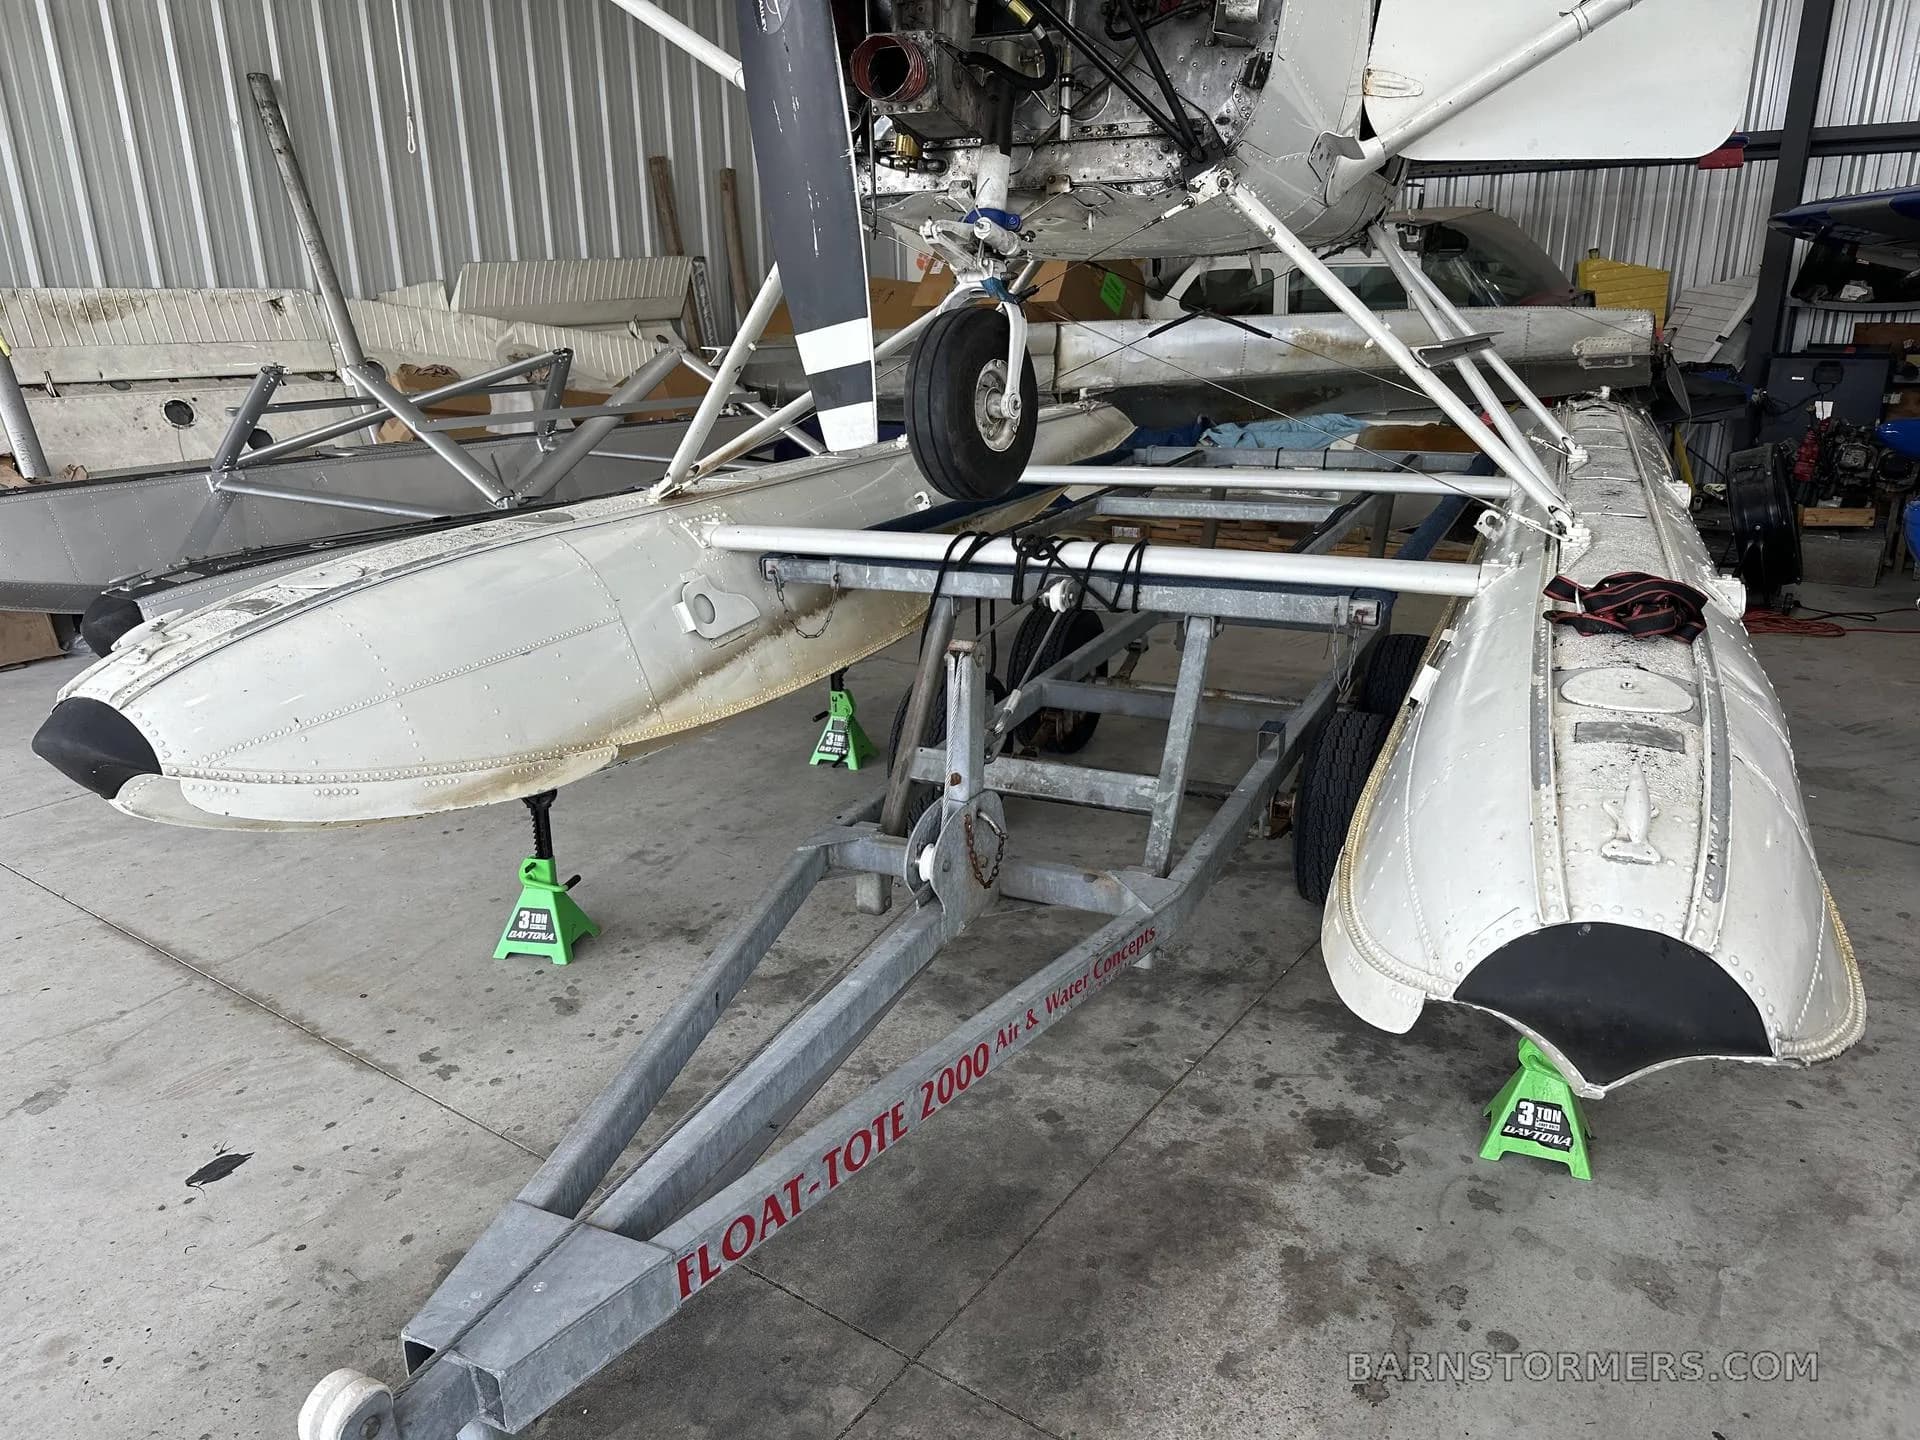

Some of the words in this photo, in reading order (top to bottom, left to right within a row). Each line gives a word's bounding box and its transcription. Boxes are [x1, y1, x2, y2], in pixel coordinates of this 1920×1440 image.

[825, 732, 835, 746] 3
[518, 910, 531, 929] 3
[531, 913, 548, 924] TON
[508, 930, 555, 941] DAYTONA
[676, 1101, 908, 1300] FLOAT-TOTE
[920, 1043, 990, 1121] 2000
[995, 1022, 1019, 1054] Air
[1026, 1009, 1039, 1030] &
[1044, 973, 1089, 1014] Water
[1093, 926, 1157, 980] Concepts
[1518, 1101, 1535, 1126] 3
[1536, 1106, 1562, 1123] TON
[1503, 1125, 1572, 1147] DAYTONA
